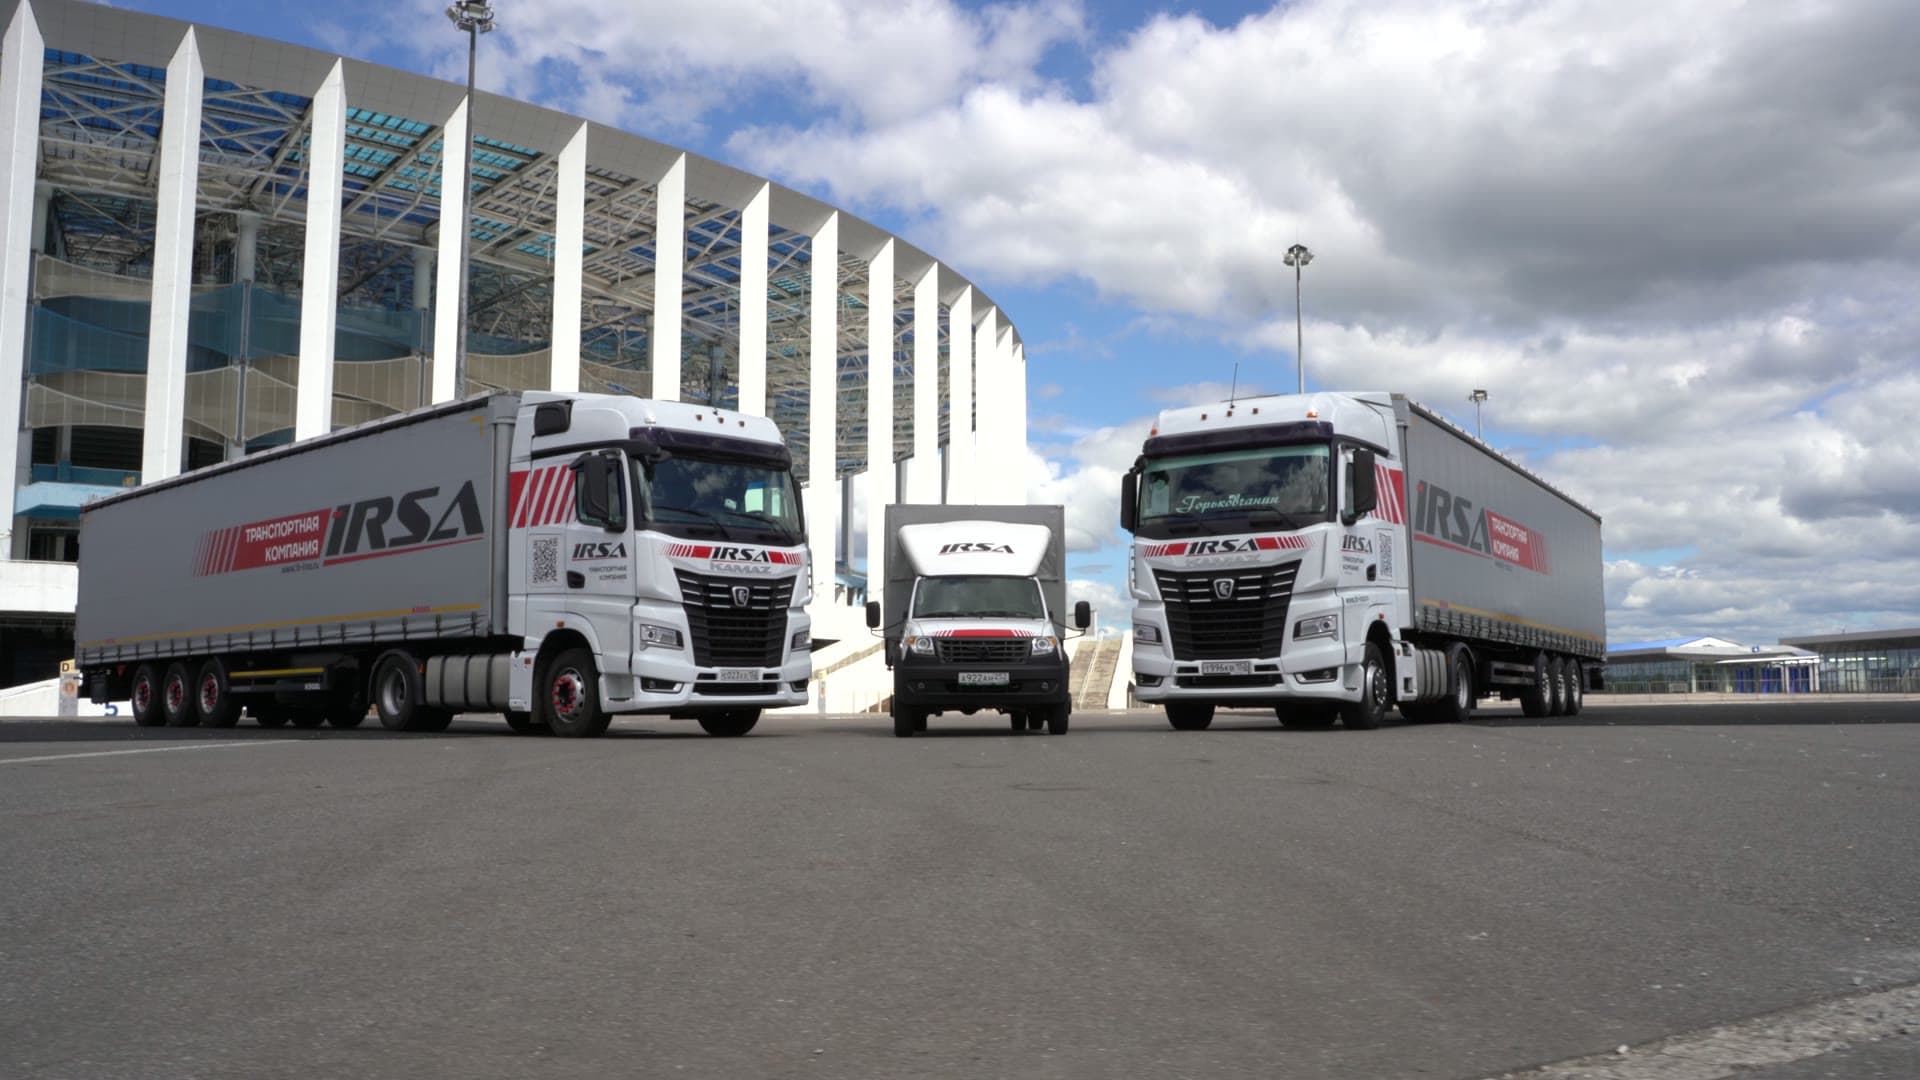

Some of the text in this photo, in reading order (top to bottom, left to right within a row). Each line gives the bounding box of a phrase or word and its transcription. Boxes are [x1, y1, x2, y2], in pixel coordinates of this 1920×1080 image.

[325, 480, 484, 557] IRSA
[1415, 480, 1491, 555] IRSA
[245, 515, 320, 543] ТРАНСПОРТНАЯ
[265, 539, 320, 562] КОМПАНИЯ
[572, 542, 628, 559] IRSA
[939, 543, 1015, 554] IRSA
[1188, 538, 1258, 555] IRSA
[1342, 534, 1373, 553] IRSA
[711, 546, 770, 562] IRSA
[711, 563, 771, 574] KAMAZ
